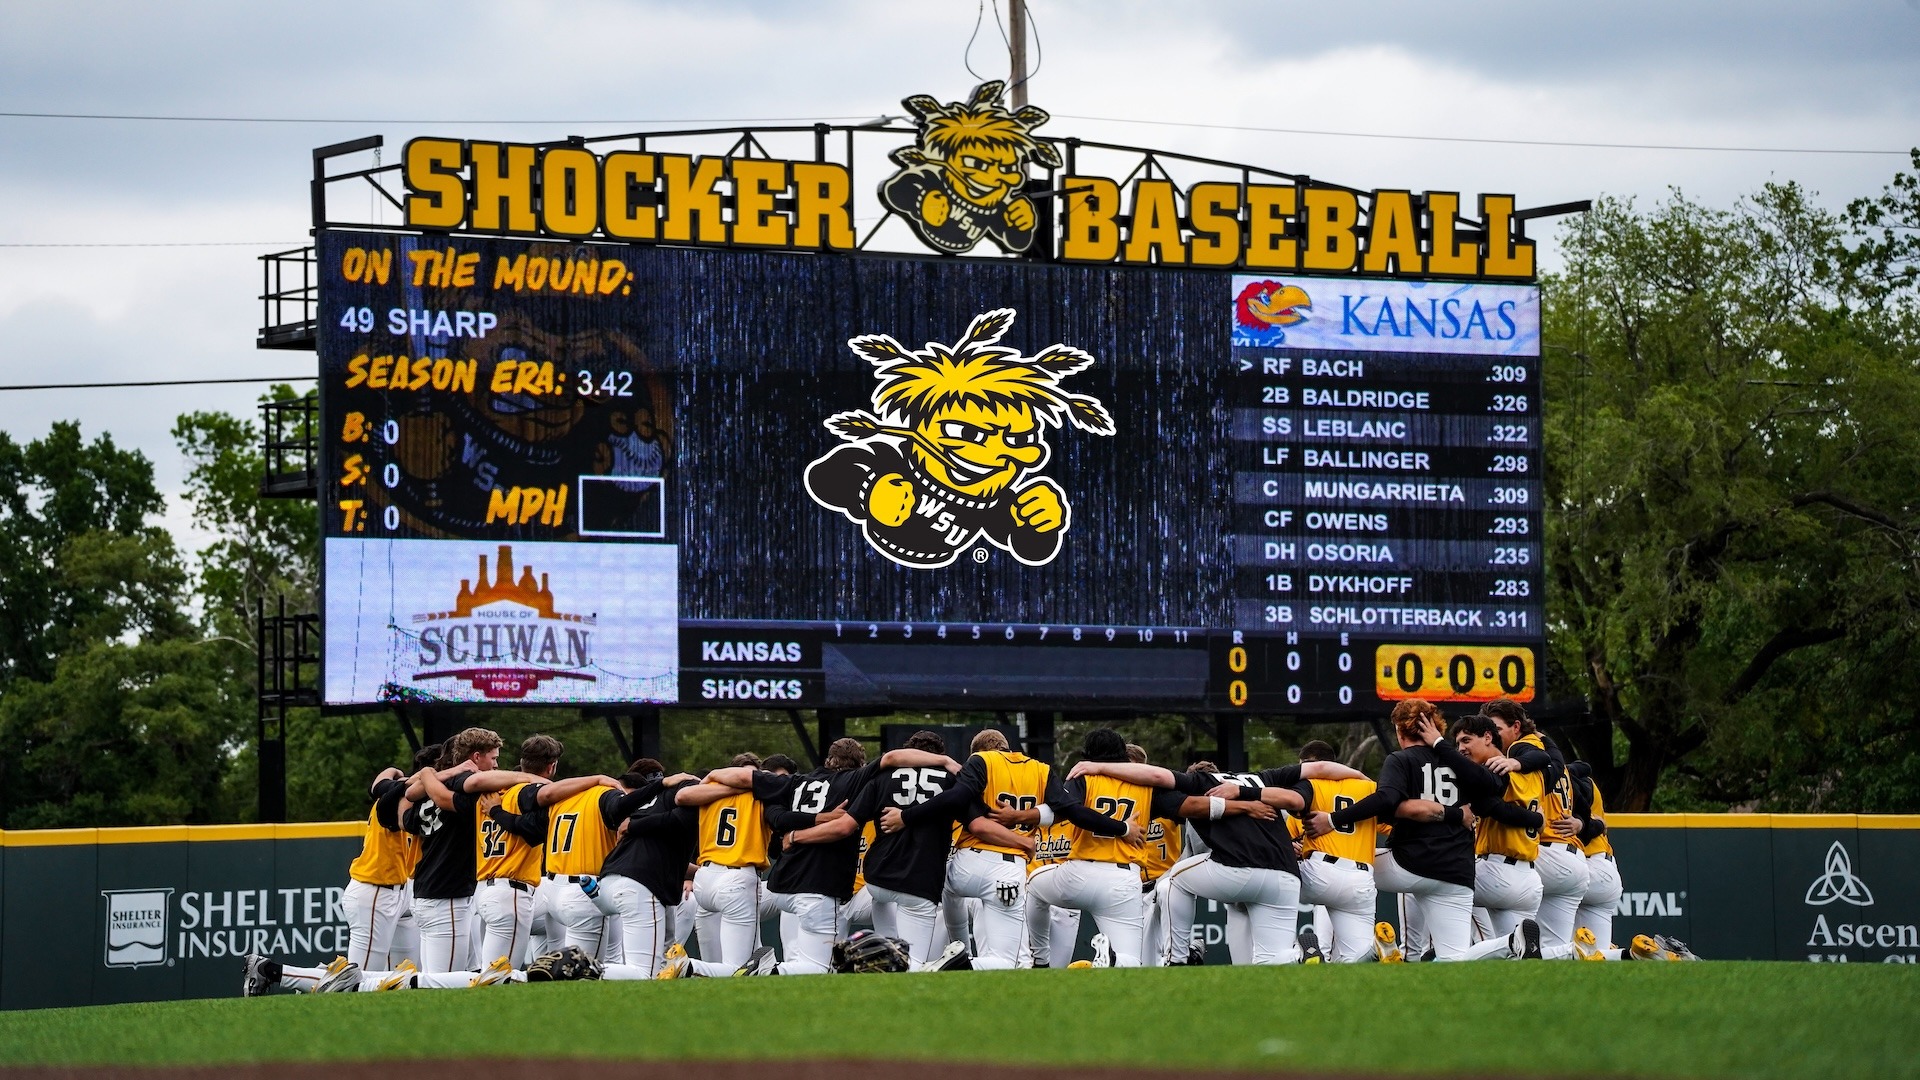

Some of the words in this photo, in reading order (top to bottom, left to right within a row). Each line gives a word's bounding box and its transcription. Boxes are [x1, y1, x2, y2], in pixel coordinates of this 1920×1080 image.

[404, 136, 856, 250] SHOCKER
[949, 204, 981, 240] WSU
[1060, 175, 1535, 279] BASEBALL
[342, 247, 392, 285] ON
[409, 247, 480, 289] THE
[494, 254, 634, 296] MOUND:
[340, 307, 374, 333] 49
[388, 309, 498, 338] SHARP
[1339, 295, 1516, 341] KANSAS
[345, 354, 477, 393] SEASON
[491, 360, 566, 395] ERA:
[577, 370, 632, 397] 3.42
[1263, 357, 1291, 375] RF
[1302, 358, 1363, 377] BACH
[1486, 366, 1527, 383] .309
[1262, 387, 1289, 404] 2B
[1302, 388, 1430, 409] BALDRIDGE
[1487, 396, 1528, 412] .326
[342, 411, 373, 443] B:
[384, 420, 399, 445] 0
[1262, 417, 1292, 435] SS
[1304, 419, 1406, 439] LEBLANC
[1487, 425, 1528, 442] .322
[340, 454, 371, 486] S:
[384, 463, 399, 488] 0
[1263, 448, 1289, 464] LF
[1304, 449, 1430, 471] BALLINGER
[1487, 456, 1528, 472] .298
[486, 484, 568, 527] MPH
[1263, 480, 1278, 497] C
[1305, 481, 1465, 502] MUNGARRIETA
[1488, 488, 1528, 504] .309
[339, 499, 368, 532] T:
[384, 505, 399, 531] 0
[915, 494, 969, 547] WSU
[1264, 511, 1292, 528] CF
[1306, 512, 1388, 531] OWENS
[1488, 518, 1529, 535] .293
[1265, 543, 1295, 560] DH
[1307, 544, 1393, 562] OSORIA
[1488, 548, 1529, 565] .235
[1266, 575, 1292, 591] 1B
[1309, 576, 1412, 594] DYKHOFF
[1489, 580, 1530, 596] .283
[835, 623, 842, 637] 1
[869, 624, 878, 638] 2
[903, 625, 912, 638] 3
[937, 625, 946, 639] 4
[972, 625, 980, 639] 5
[1005, 626, 1014, 640] 6
[1039, 627, 1049, 640] 7
[1073, 627, 1082, 641] 8
[1105, 628, 1115, 641] 9
[1138, 628, 1153, 642] 10
[1174, 630, 1188, 643] 11
[1265, 606, 1292, 623] 3B
[1310, 607, 1482, 627] SCHLOTTERBACK
[1489, 611, 1527, 627] .311
[419, 624, 589, 667] SCHWAN
[702, 641, 802, 662] KANSAS
[1233, 631, 1243, 644] R
[1287, 632, 1297, 645] H
[1341, 632, 1349, 646] E
[1229, 647, 1247, 673] 0
[1287, 652, 1300, 671] 0
[1339, 653, 1351, 671] 0
[1397, 652, 1423, 692] 0
[1449, 653, 1475, 694] 0
[1499, 654, 1526, 694] 0
[491, 681, 520, 691] 1960
[701, 679, 802, 699] SHOCKS
[1229, 680, 1247, 705] 0
[1287, 685, 1300, 704] 0
[1339, 686, 1352, 704] 0
[792, 780, 830, 813] 13
[891, 767, 947, 806] 35
[1420, 763, 1458, 806] 16
[480, 820, 506, 858] 32
[551, 812, 579, 854] 17
[716, 807, 737, 847] 6
[1034, 833, 1072, 853] ichita
[112, 910, 162, 921] SHELTER
[180, 887, 348, 930] SHELTER
[112, 921, 162, 930] INSURANCE
[178, 925, 349, 958] INSURANCE
